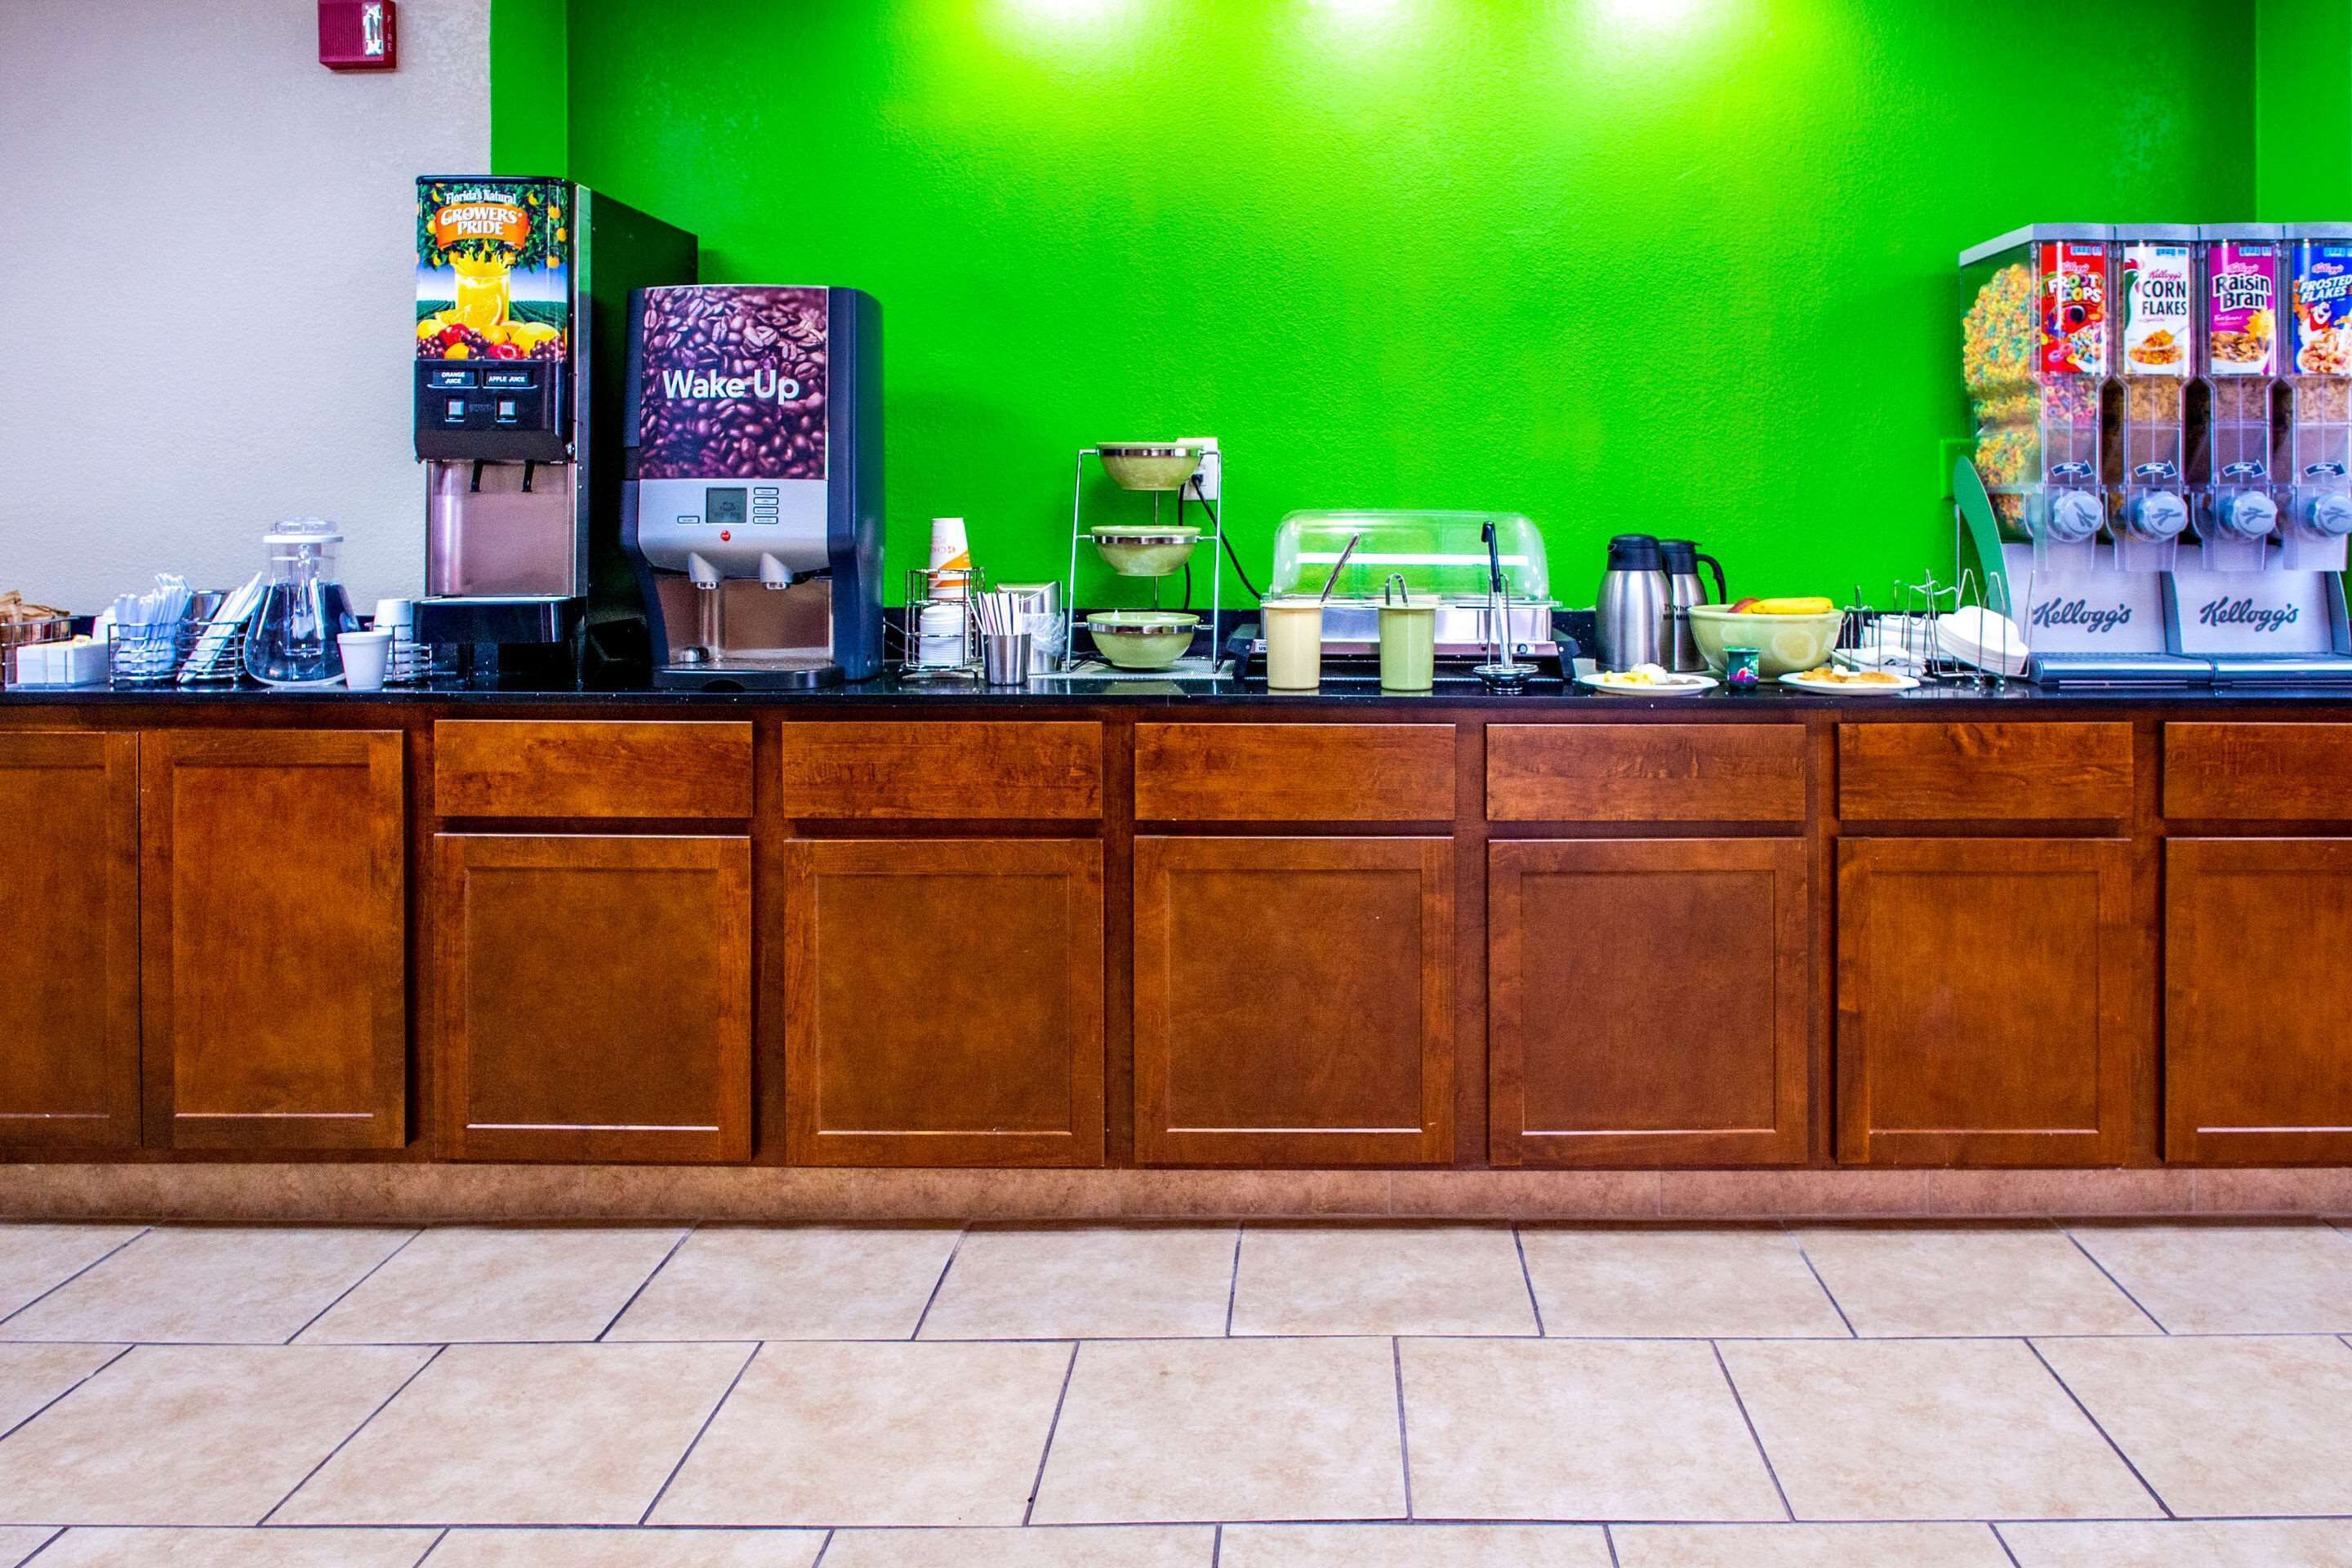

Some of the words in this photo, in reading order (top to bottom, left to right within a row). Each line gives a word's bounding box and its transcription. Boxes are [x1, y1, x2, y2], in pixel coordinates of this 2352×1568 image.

[483, 189, 516, 204] Natural
[457, 220, 504, 235] PRIDE
[2149, 269, 2182, 281] Kellogg's
[2299, 274, 2352, 293] FROSTED
[2047, 274, 2100, 294] FROOT
[2142, 280, 2185, 298] CORN
[2214, 275, 2270, 294] Raisin
[2060, 287, 2102, 303] LOOPS
[2222, 292, 2265, 309] Bran
[2300, 286, 2346, 303] FLAKES
[2142, 301, 2187, 315] FLAKES
[662, 368, 746, 399] Wake
[753, 369, 800, 406] Up
[2032, 597, 2132, 633] Kellogg's
[2199, 596, 2299, 632] Kellogg's
